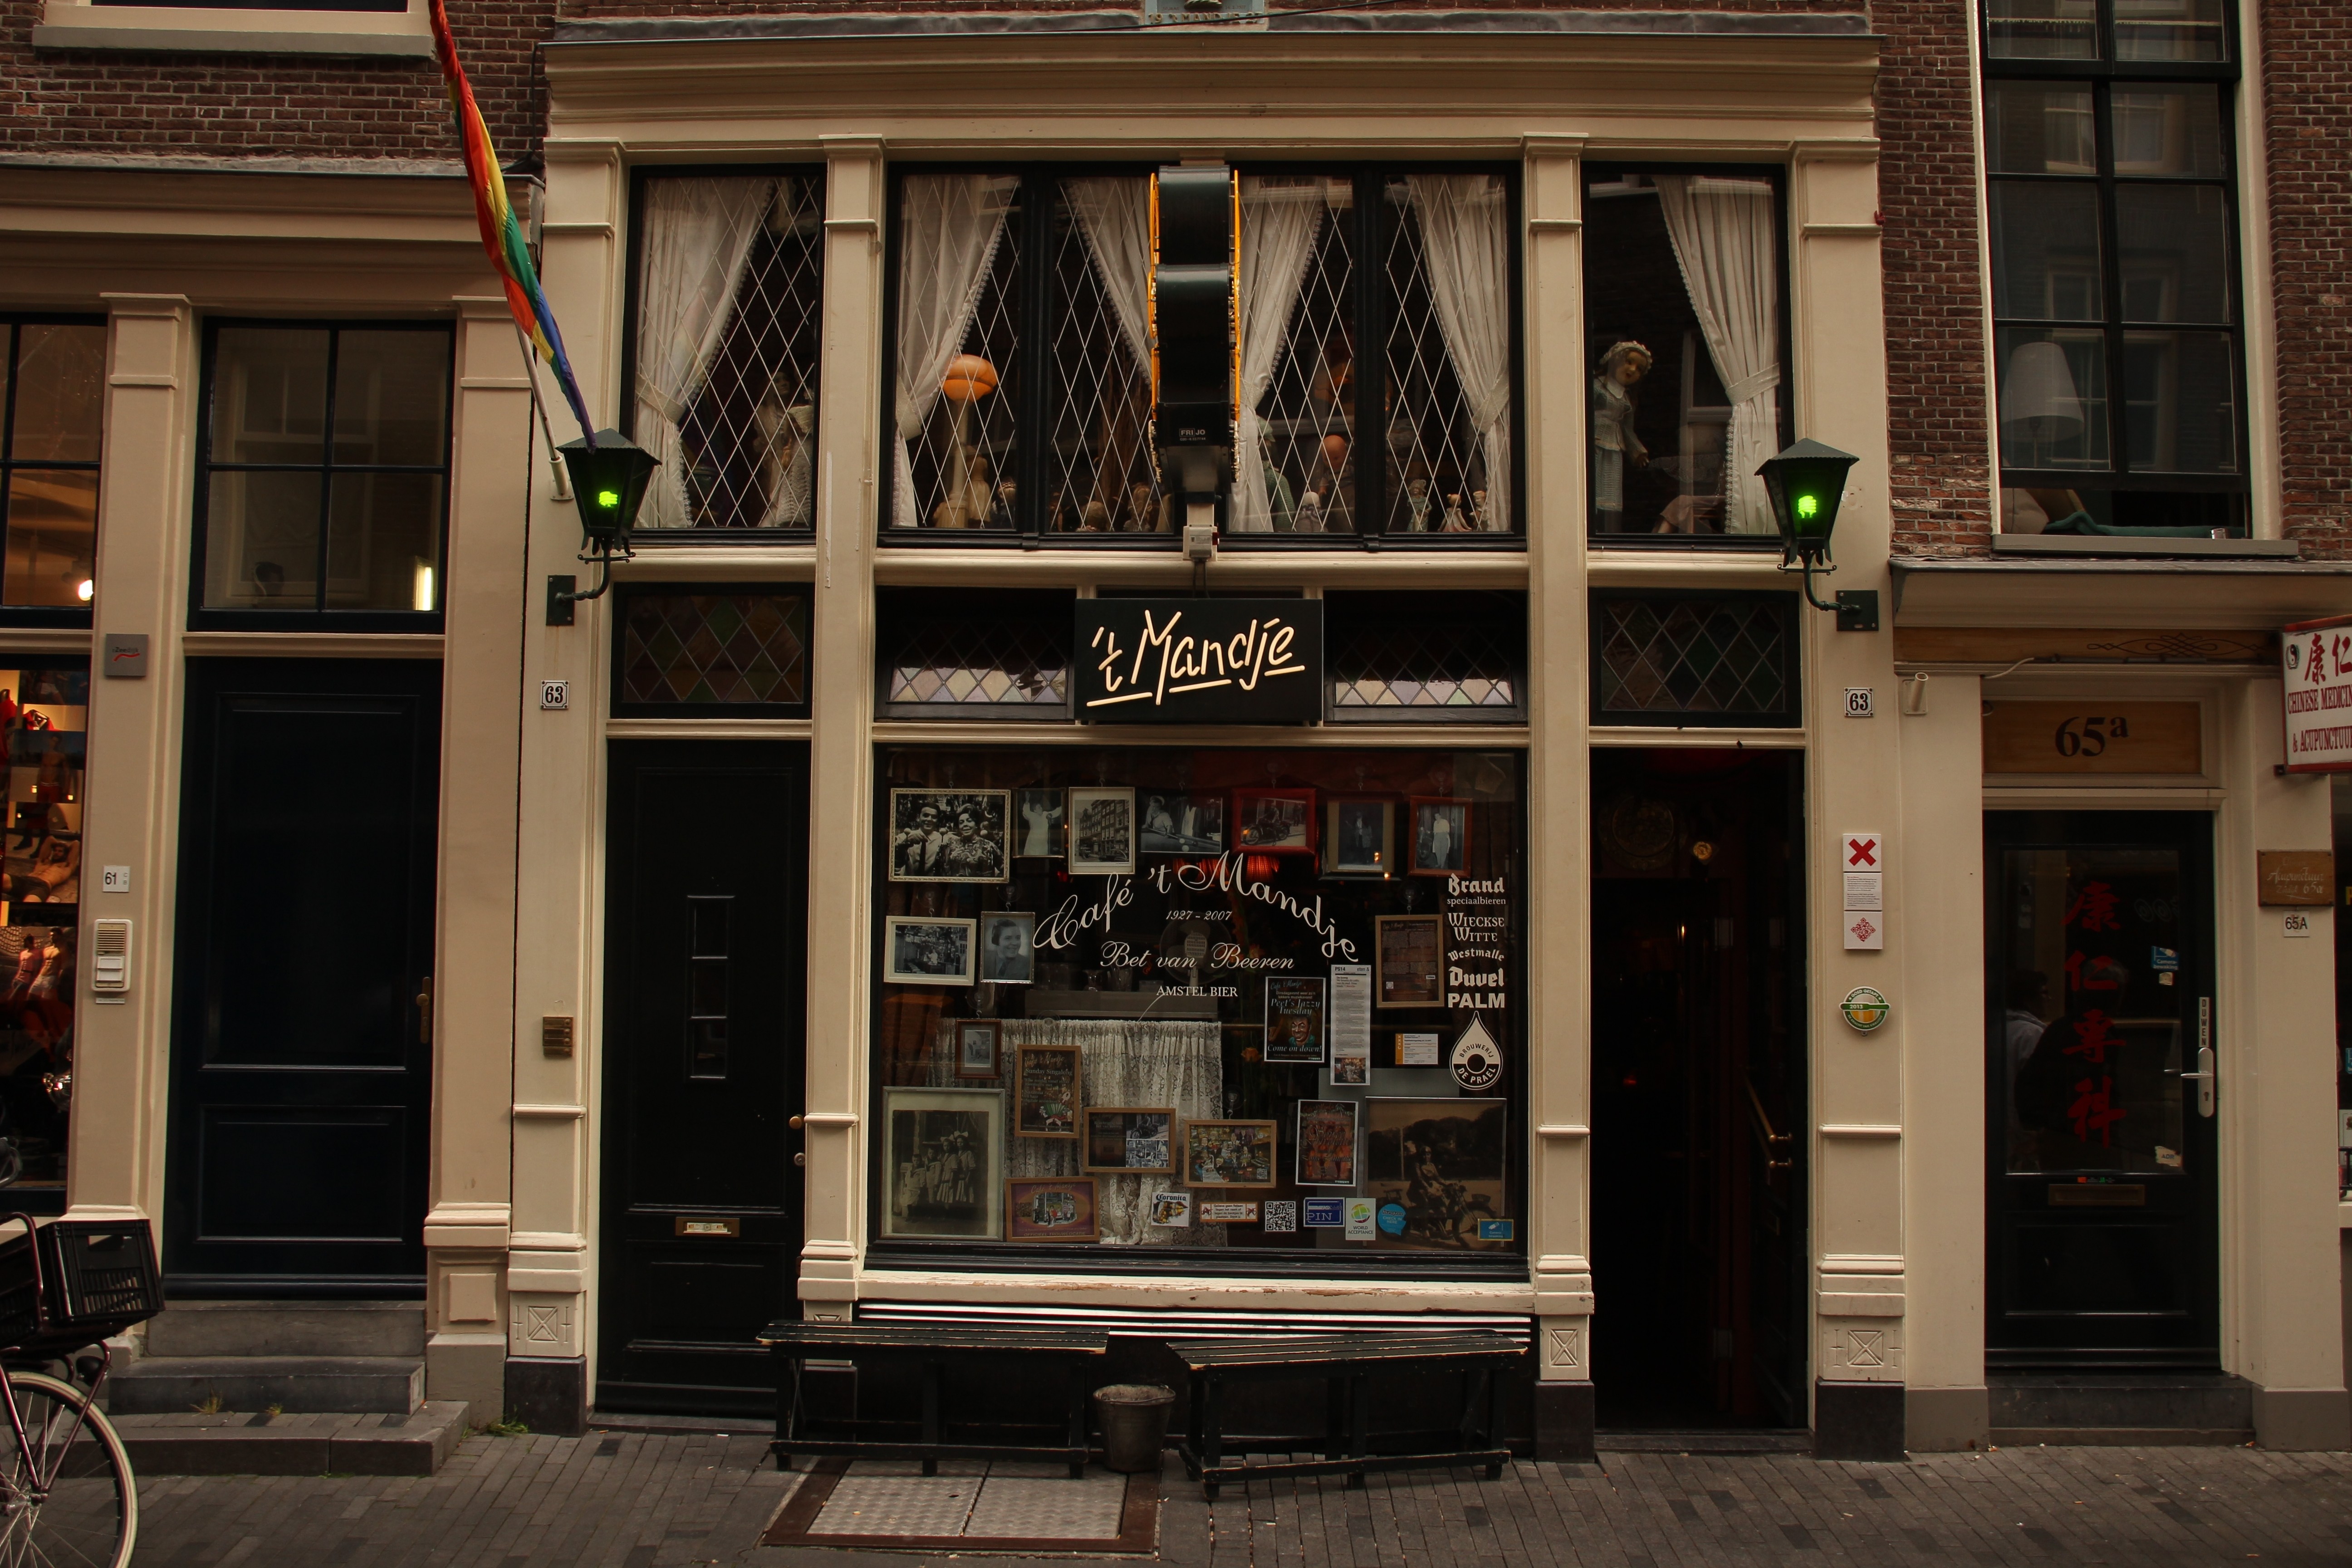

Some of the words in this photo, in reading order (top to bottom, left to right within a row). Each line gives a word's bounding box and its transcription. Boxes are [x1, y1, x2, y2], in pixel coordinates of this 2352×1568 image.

[1148, 13, 1163, 24] 19
[1091, 626, 1123, 691] 't
[545, 686, 563, 703] 63
[2288, 688, 2318, 714] CHINESE
[1850, 693, 1868, 711] 63
[2055, 716, 2129, 757] 65a
[2293, 733, 2298, 753] &
[105, 872, 117, 885] 61
[1448, 872, 1505, 897] Brand
[1032, 872, 1133, 949] Café
[1147, 864, 1171, 893] 't
[1178, 850, 1359, 962] Mandje
[1447, 896, 1506, 907] speciaalbieren
[1166, 910, 1193, 920] 1927
[1203, 910, 1233, 921] 2007
[2285, 916, 2308, 930] 65A
[1100, 941, 1152, 967] Bet
[1156, 956, 1197, 968] van
[1210, 942, 1294, 969] Beeren
[1447, 947, 1504, 961] Westmalle
[1448, 965, 1504, 987] Duvel
[1156, 985, 1207, 997] AMSTEL
[1210, 986, 1238, 997] BIER
[1851, 989, 1862, 998] GOED
[1863, 989, 1879, 998] GETAPT
[1270, 999, 1295, 1007] Peet's
[1298, 999, 1321, 1009] Jazzy
[1447, 993, 1505, 1008] PALM
[1279, 1006, 1313, 1015] Tuesday
[1299, 1044, 1322, 1053] down!
[1459, 1043, 1494, 1058] BROUWERIJ
[1458, 1067, 1469, 1079] DE
[1470, 1068, 1496, 1084] PRAEL
[1031, 1185, 1044, 1194] Café
[1156, 1193, 1187, 1202] Coronita
[1306, 1212, 1333, 1220] PIN
